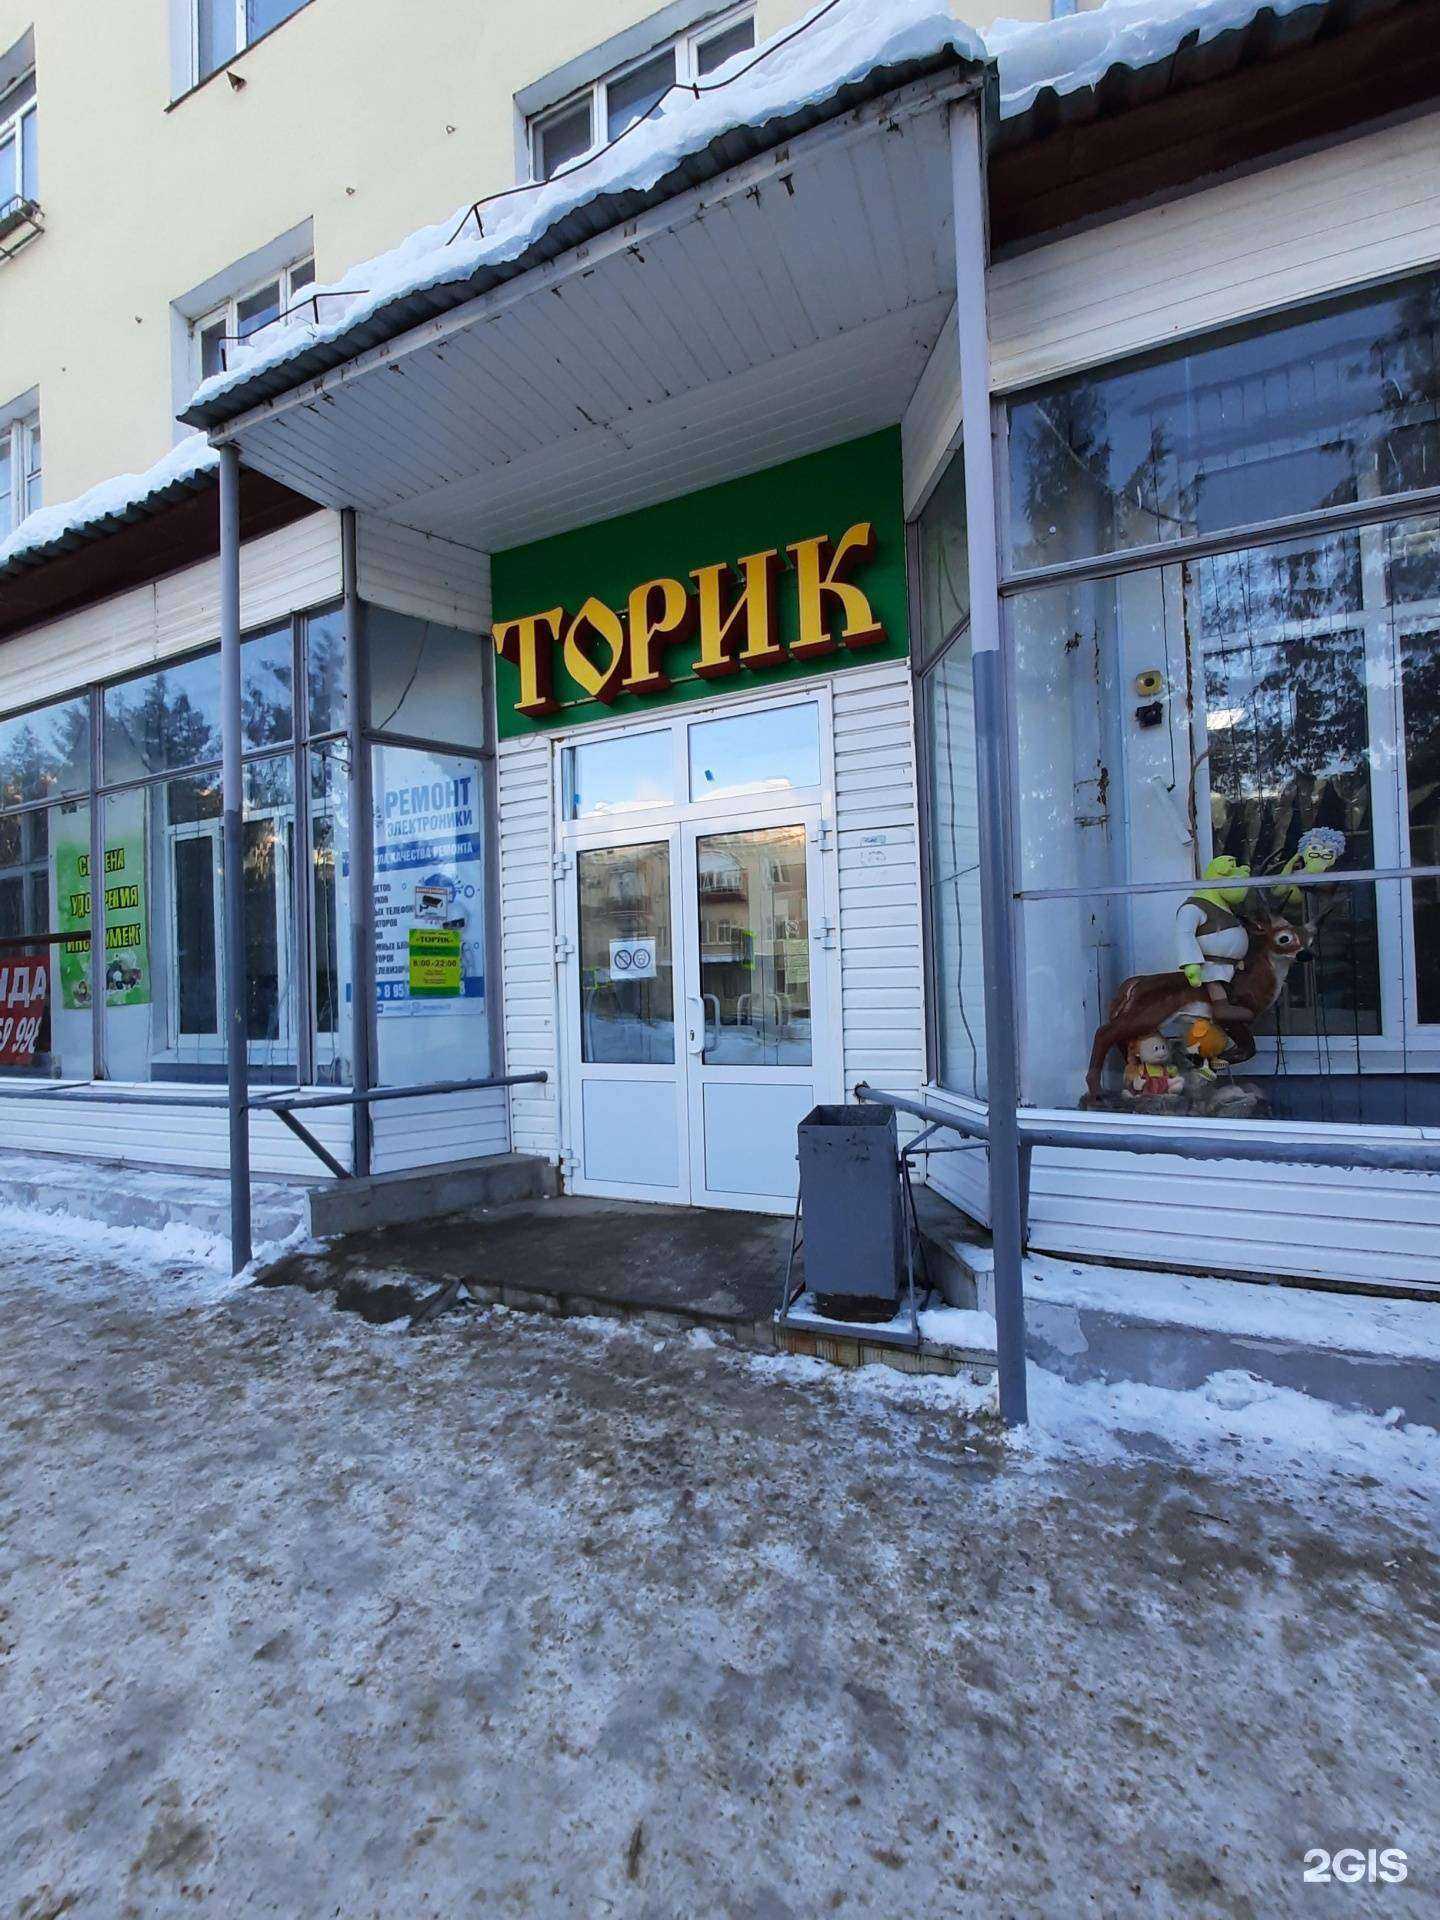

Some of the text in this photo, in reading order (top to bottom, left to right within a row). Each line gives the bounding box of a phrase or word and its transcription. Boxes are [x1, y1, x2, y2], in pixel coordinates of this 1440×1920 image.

[491, 522, 888, 718] ТОРИК
[384, 777, 471, 818] РЕМОНТ
[387, 809, 473, 837] ЭЛЕКТРОНИКИ
[78, 848, 125, 877] СЕНА
